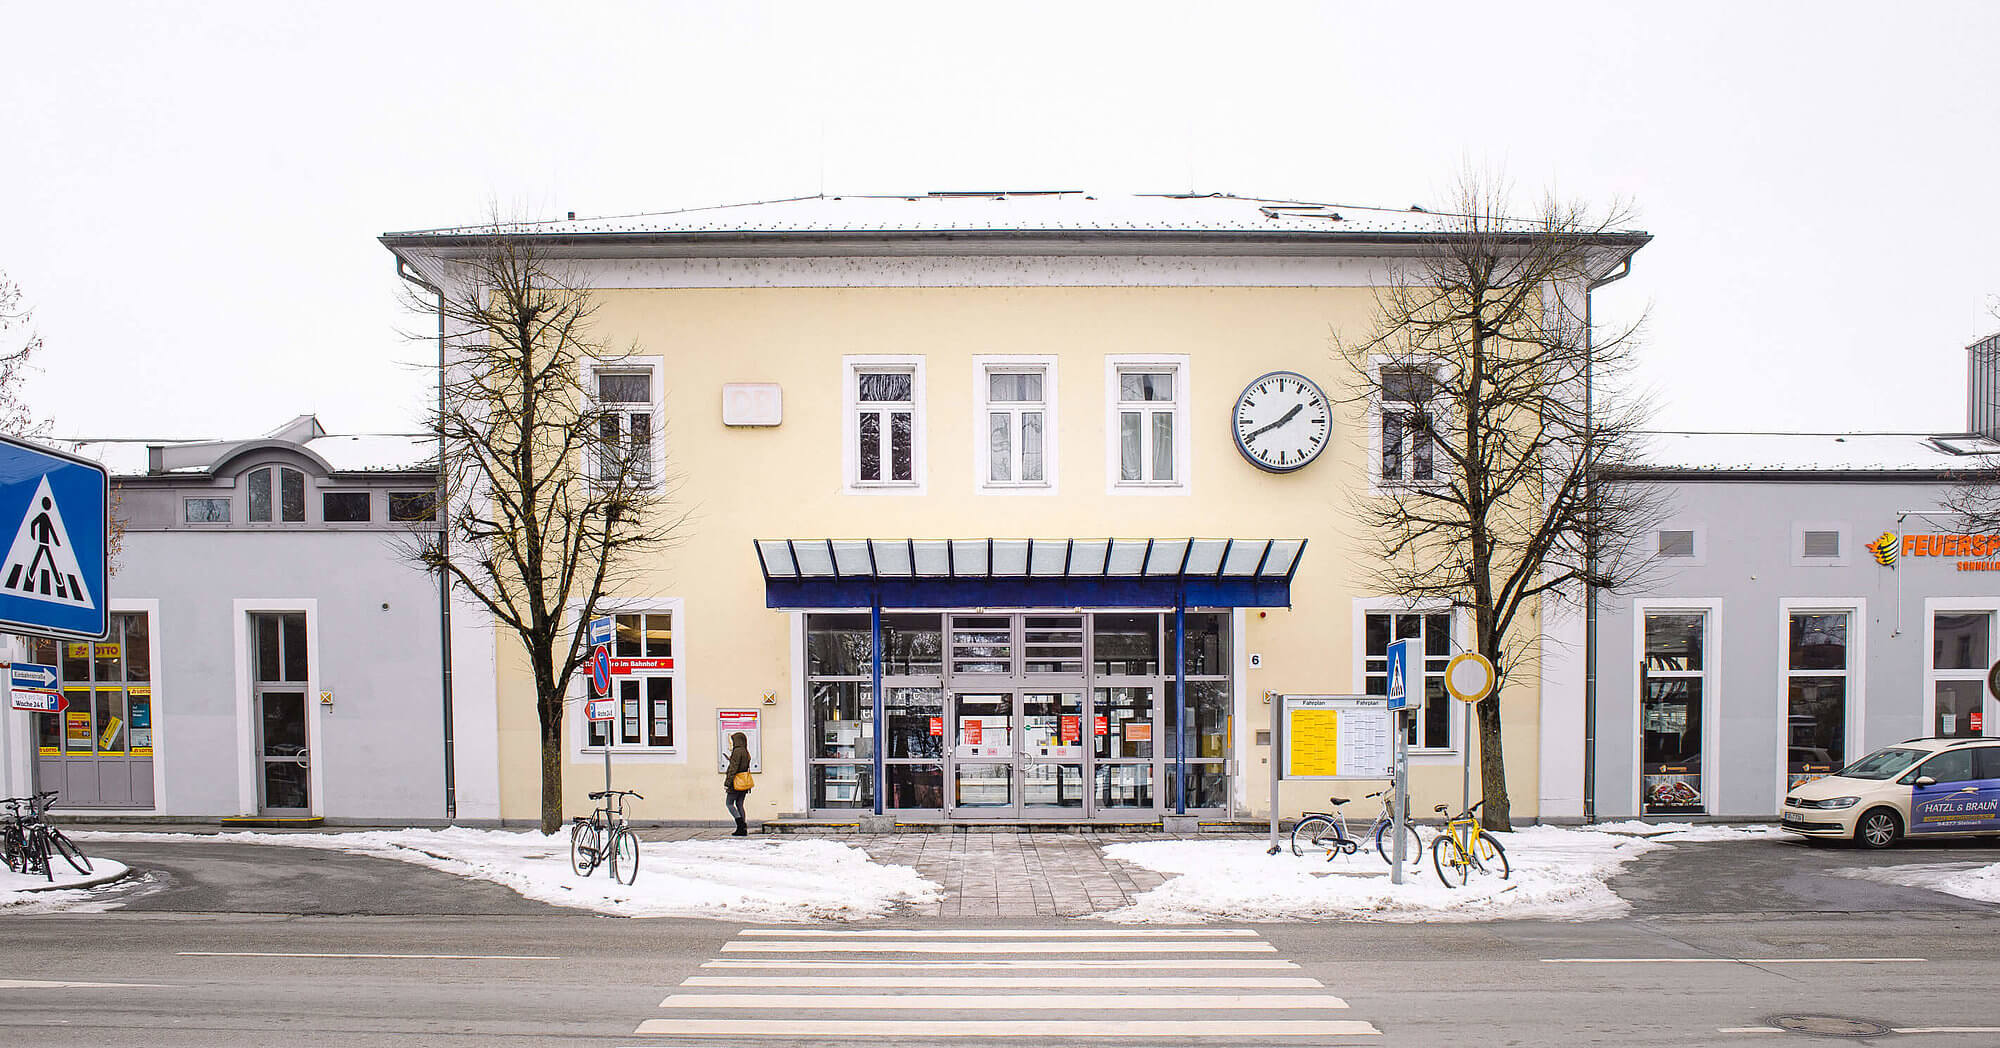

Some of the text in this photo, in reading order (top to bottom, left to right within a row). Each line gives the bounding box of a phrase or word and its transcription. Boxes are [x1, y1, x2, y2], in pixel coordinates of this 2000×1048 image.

[95, 646, 118, 655] OTTO
[1252, 655, 1259, 665] 6
[48, 695, 56, 709] P
[1925, 803, 1954, 813] HATZL
[1956, 804, 1963, 812] &
